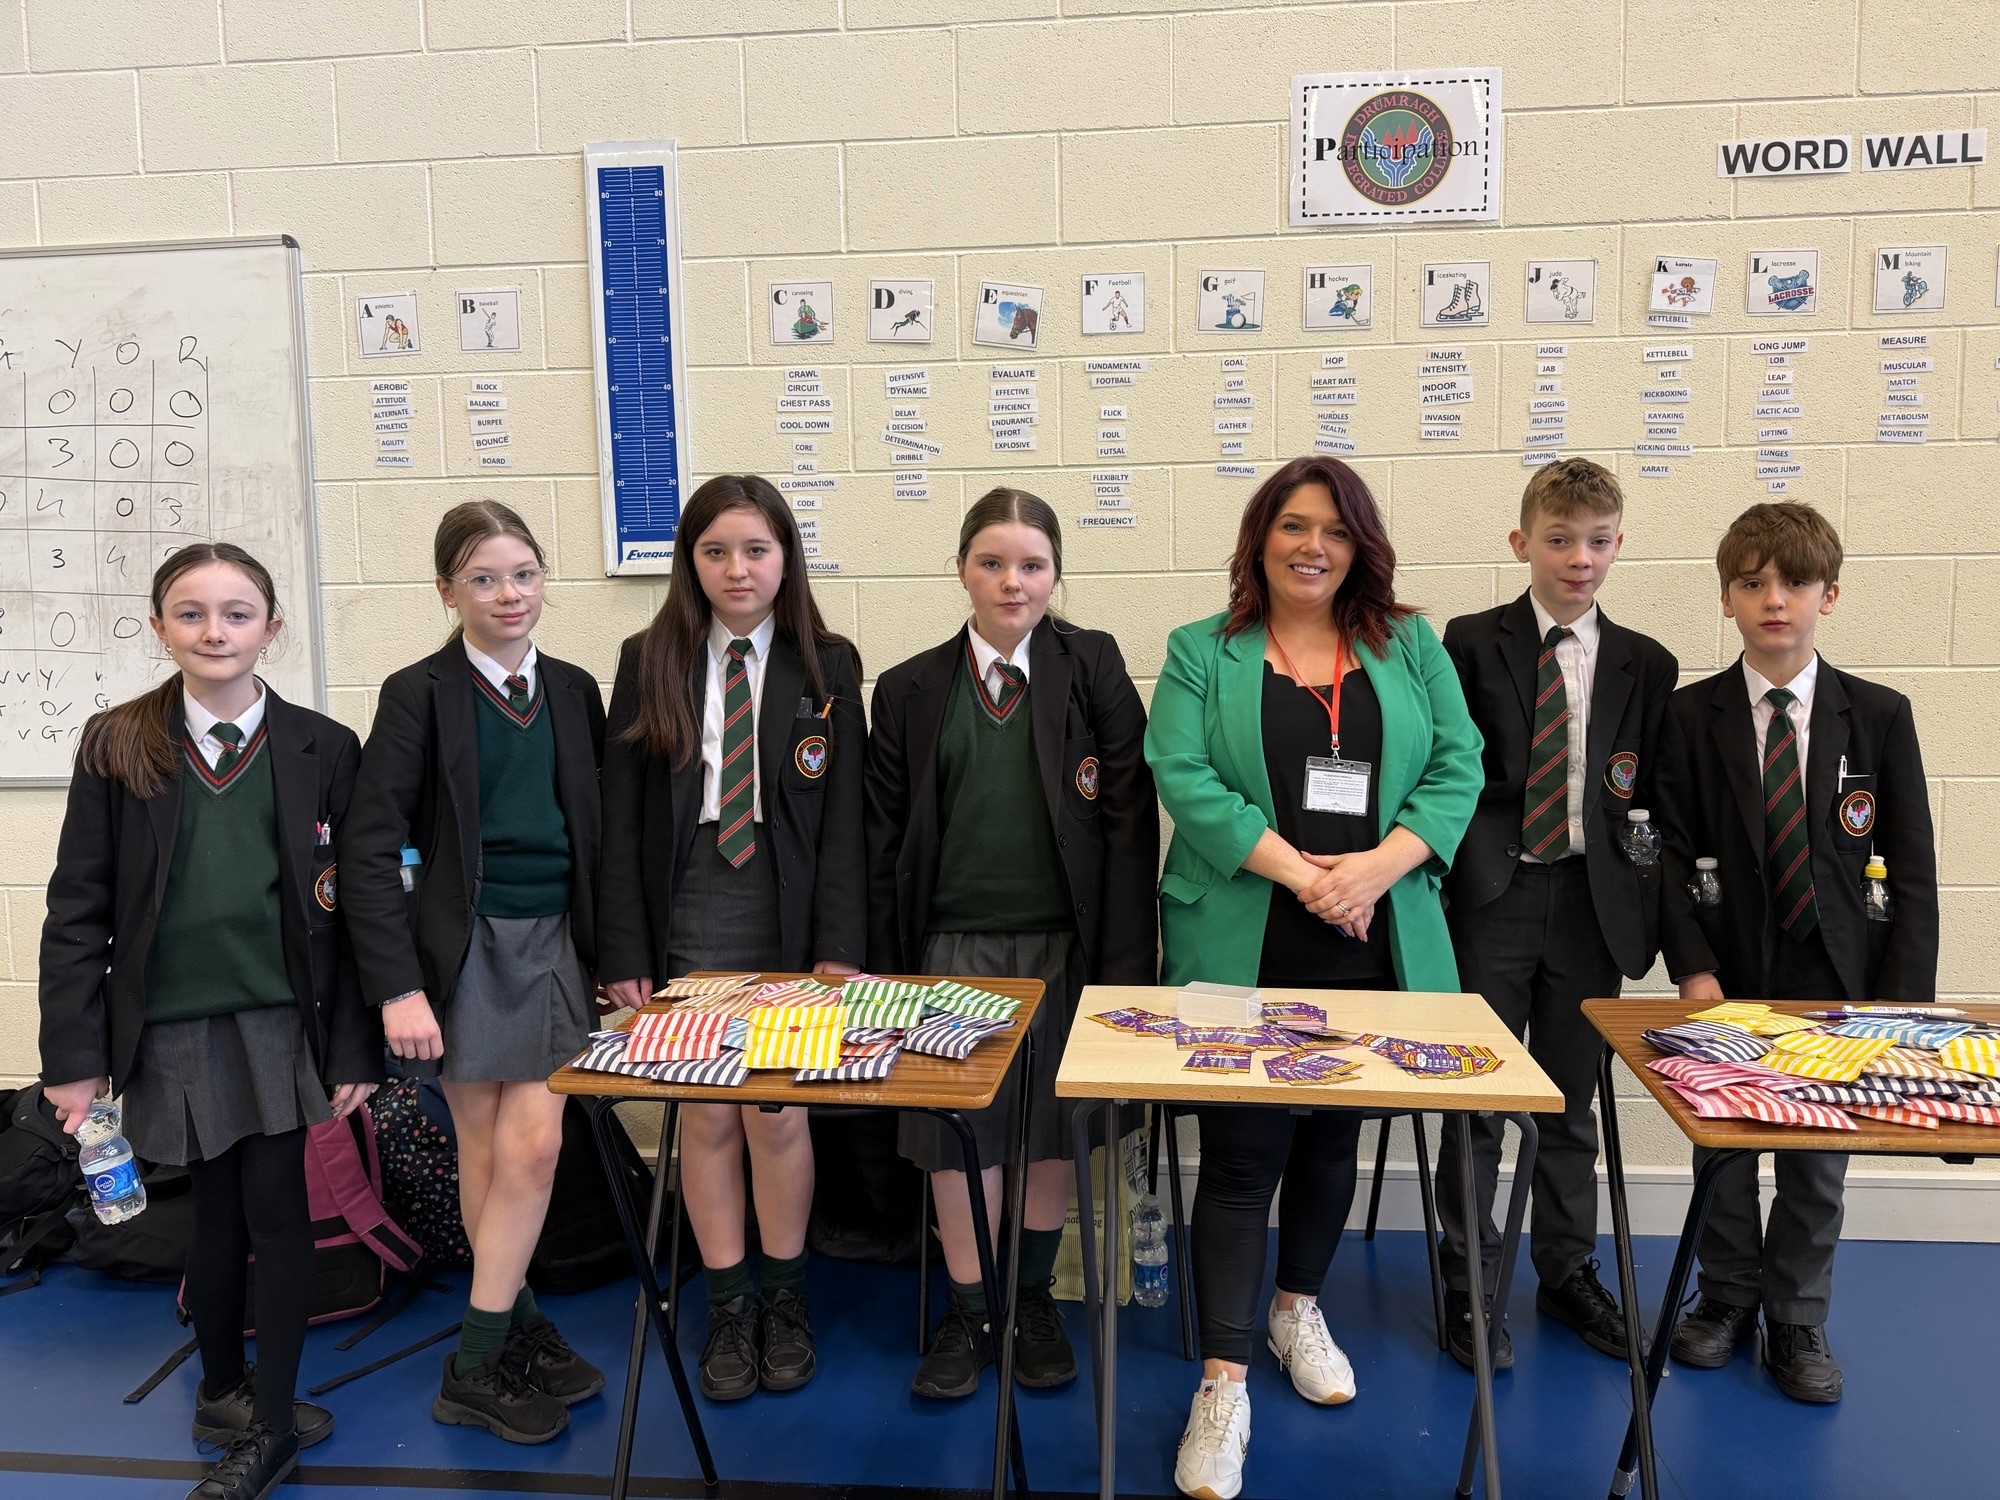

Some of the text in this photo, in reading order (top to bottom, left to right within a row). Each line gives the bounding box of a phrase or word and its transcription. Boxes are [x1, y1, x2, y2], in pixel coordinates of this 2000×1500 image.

[1354, 93, 1441, 127] DRUMRAGH
[1313, 137, 1479, 165] Participation
[1722, 133, 1983, 174] WORD WALL
[1657, 261, 1669, 272] K
[1752, 258, 1768, 273] L
[1880, 254, 1901, 270] M
[1309, 273, 1348, 289] H hockey
[1427, 270, 1436, 285] I
[1529, 268, 1562, 283] J judo
[1084, 280, 1099, 295] F
[1203, 276, 1236, 292] G golf
[774, 290, 787, 305] C
[873, 289, 895, 309] D
[983, 289, 1028, 304] E equestrian
[1768, 287, 1814, 303] LACROSSE
[361, 304, 374, 318] A
[462, 299, 476, 313] B
[1882, 336, 1926, 345] MEASURE
[55, 336, 206, 371] Y R
[1646, 350, 1688, 358] KETTLEBELL
[1422, 365, 1467, 373] INTENSITY
[1884, 362, 1926, 370] MUSCULAR
[889, 372, 925, 382] DEFENSIVE
[992, 370, 1035, 378] EVALUATE
[1422, 382, 1456, 391] INDOOR
[1423, 392, 1470, 403] ATHLETICS
[1644, 390, 1687, 398] KICKBOXING
[374, 409, 409, 419] ALTERNATE
[992, 418, 1033, 426] ENDURANCE
[1321, 425, 1346, 434] HEALTH
[1761, 429, 1788, 437] LIFTING
[476, 436, 509, 447] BOUNCE
[885, 435, 940, 454] DETERMINATION
[1526, 433, 1564, 442] JUMPSHOT
[1315, 440, 1354, 450] HYDRATION
[48, 438, 74, 468] 3
[1524, 452, 1556, 460] JUMPING
[792, 480, 834, 488] ORDINATION
[161, 498, 182, 526] 3
[52, 549, 65, 568] 3
